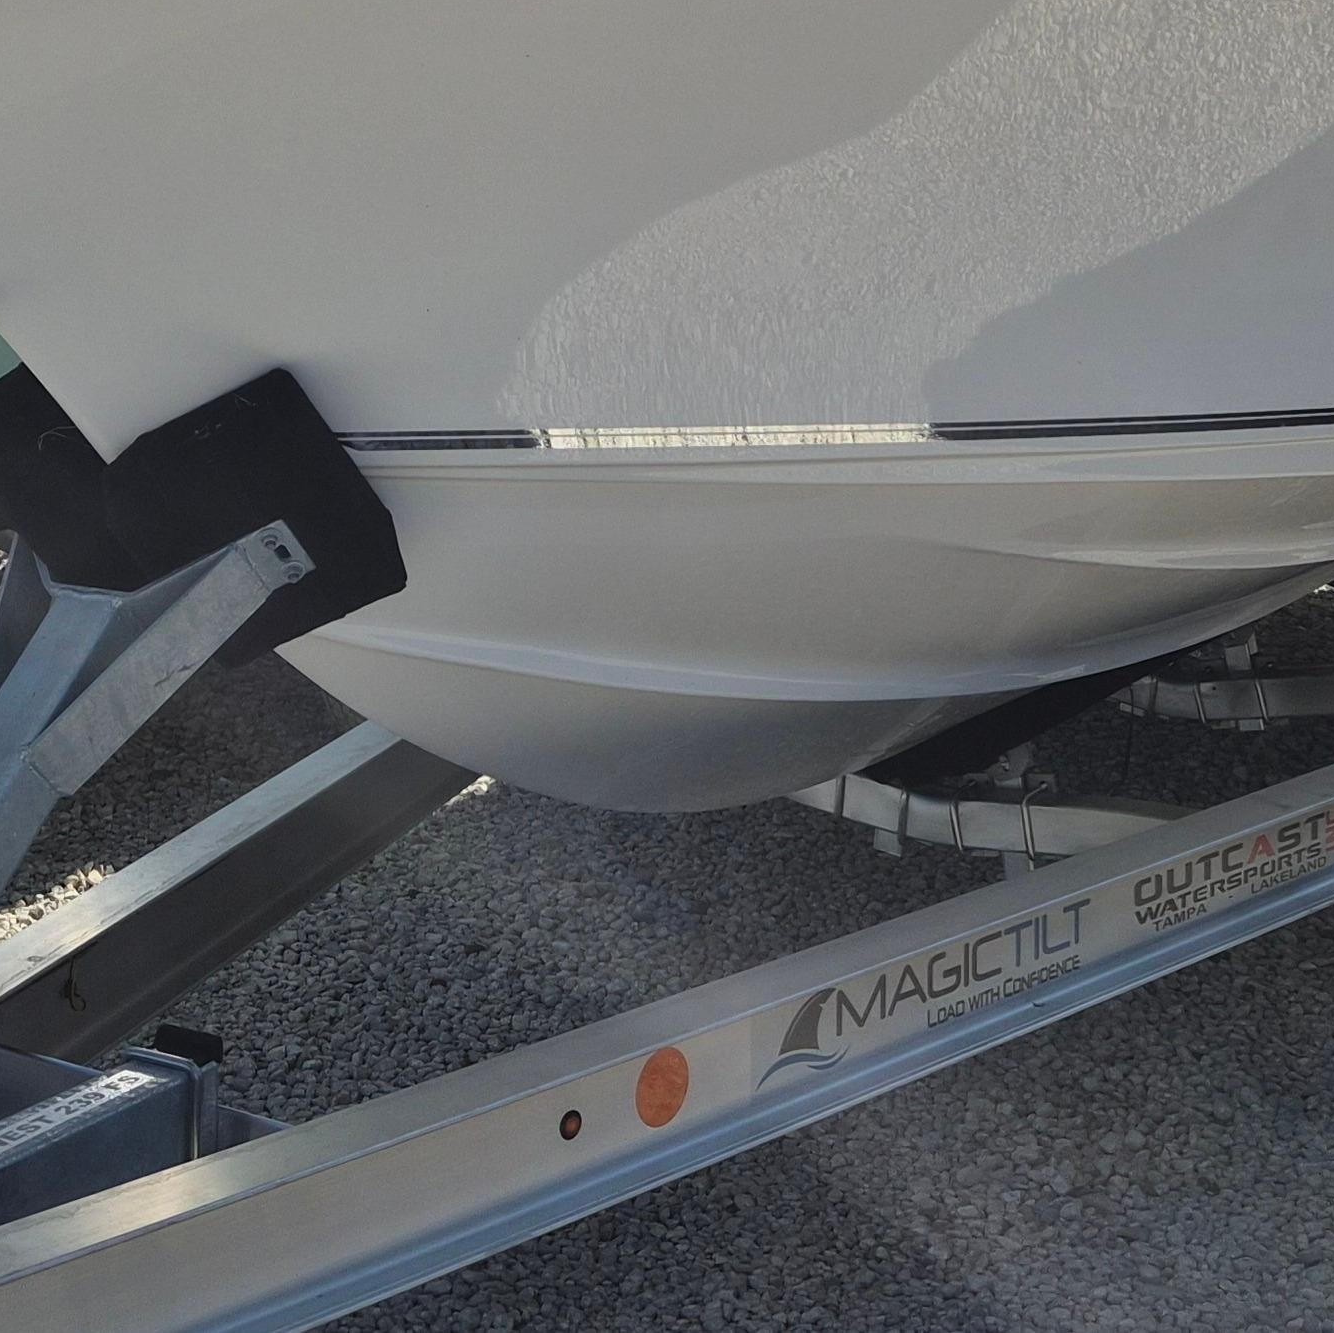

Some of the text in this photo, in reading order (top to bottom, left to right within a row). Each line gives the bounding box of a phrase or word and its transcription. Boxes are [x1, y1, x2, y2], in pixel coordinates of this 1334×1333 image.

[1133, 812, 1326, 907] OUTCAST
[1134, 841, 1322, 925] WATERSPORTS
[1153, 856, 1327, 932] TAMPA LAKELAND
[835, 897, 1091, 1037] MAGICTILT
[927, 999, 966, 1028] LOAD
[968, 985, 1000, 1011] WITH
[54, 1091, 106, 1115] 239
[101, 1073, 141, 1092] FS
